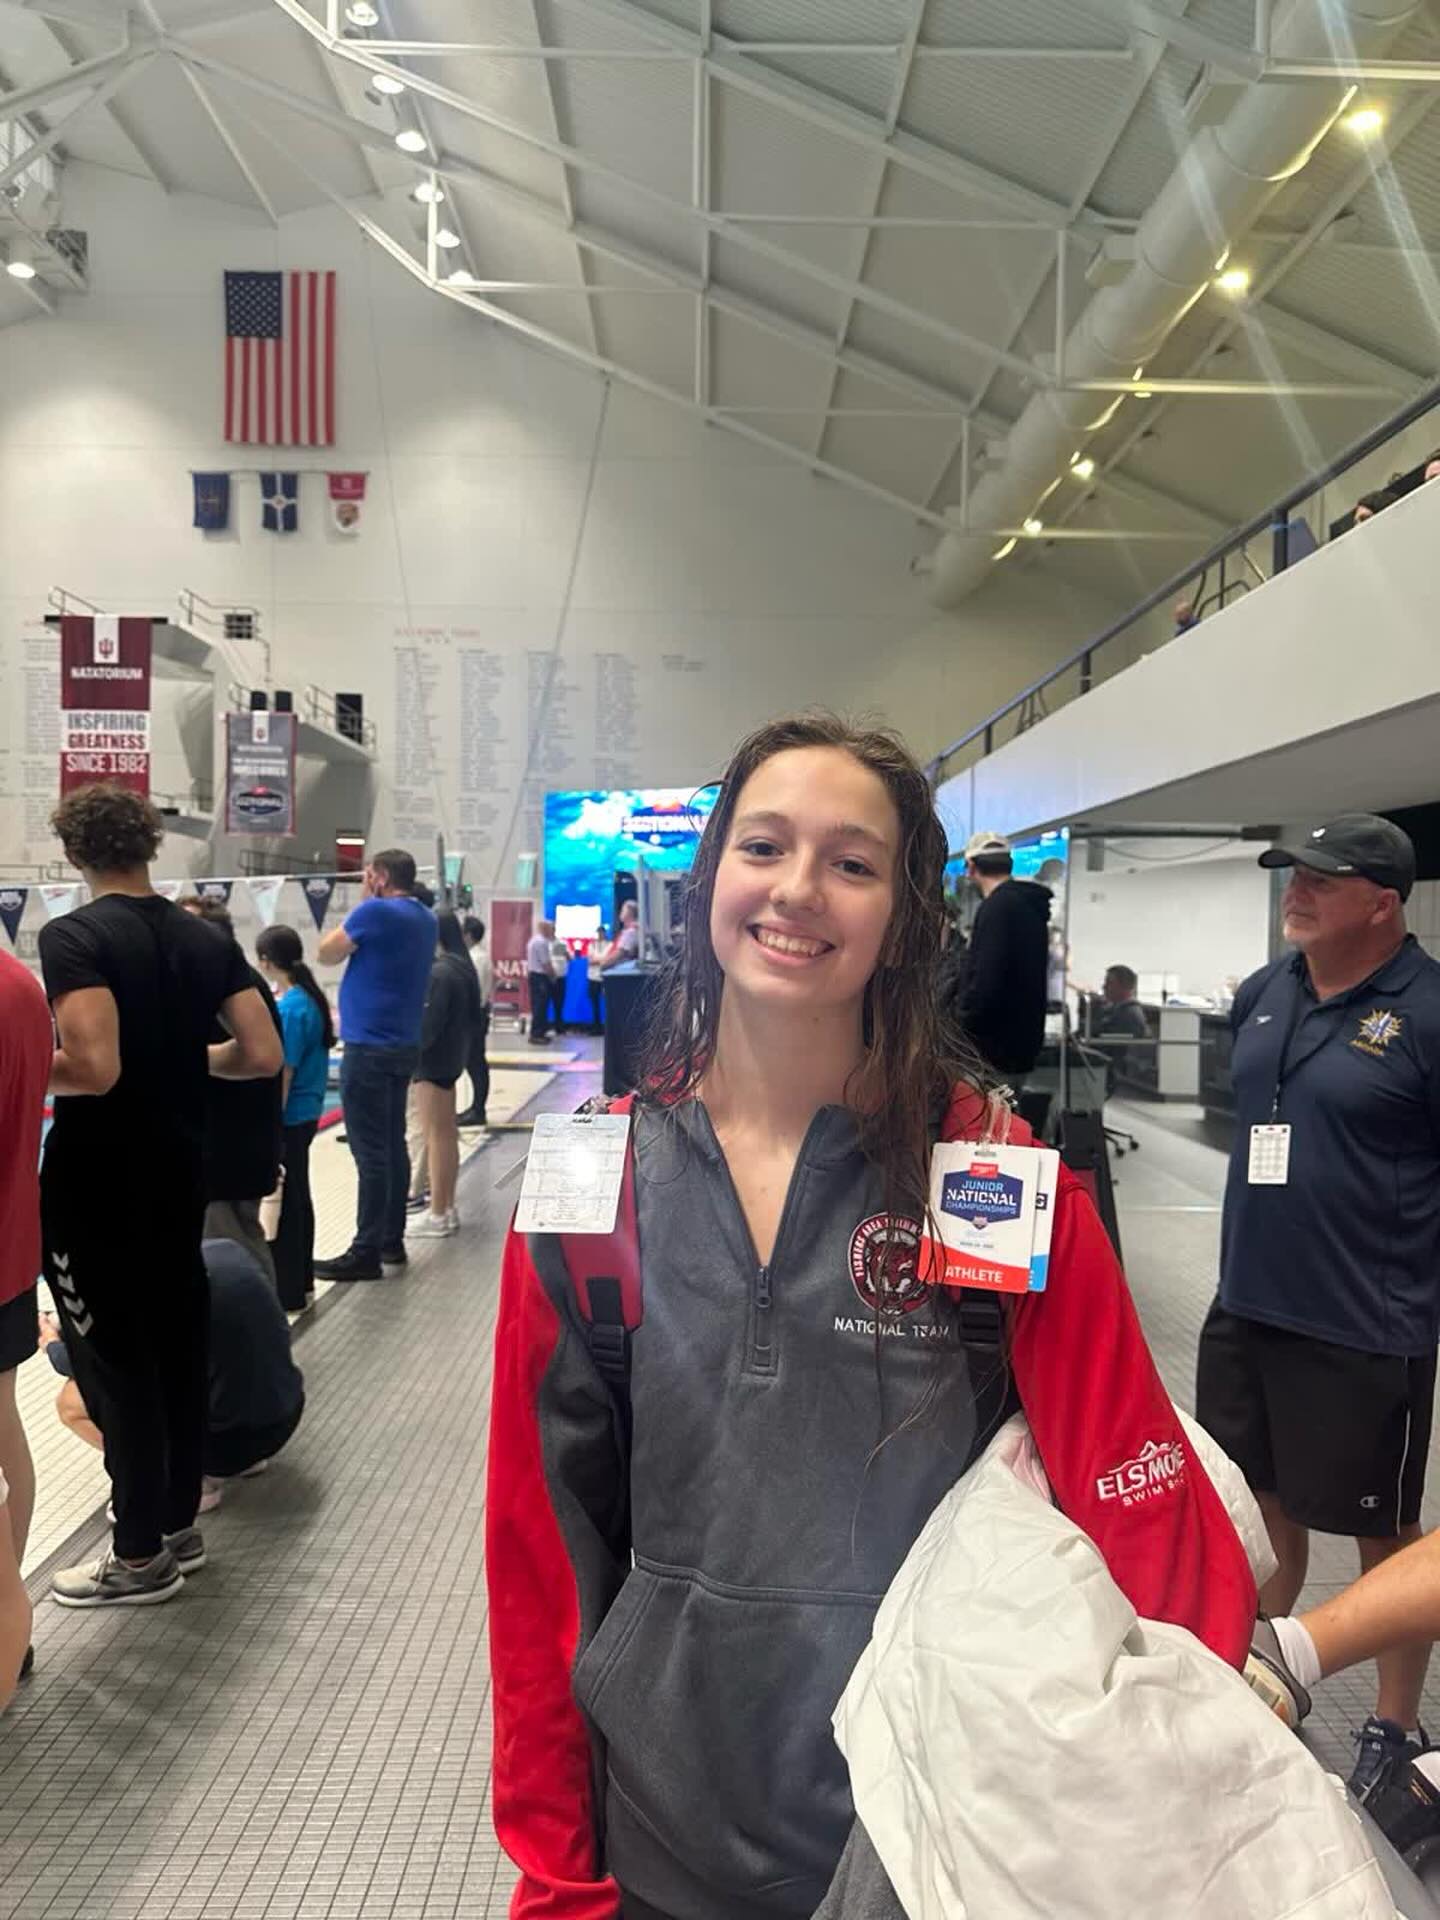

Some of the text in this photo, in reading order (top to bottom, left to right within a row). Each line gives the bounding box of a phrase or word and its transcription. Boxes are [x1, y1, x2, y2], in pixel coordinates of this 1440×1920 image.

[67, 713, 147, 731] INSPIRING
[68, 733, 146, 749] GREATNESS
[66, 754, 147, 774] SINCE 1982
[961, 1180, 1004, 1193] JUNIOR
[946, 1188, 1017, 1207] NATIONAL
[945, 1200, 1017, 1215] CHAMPIONSHIPS
[944, 1265, 1004, 1284] ATHLETE
[1122, 1484, 1165, 1507] SWIM
